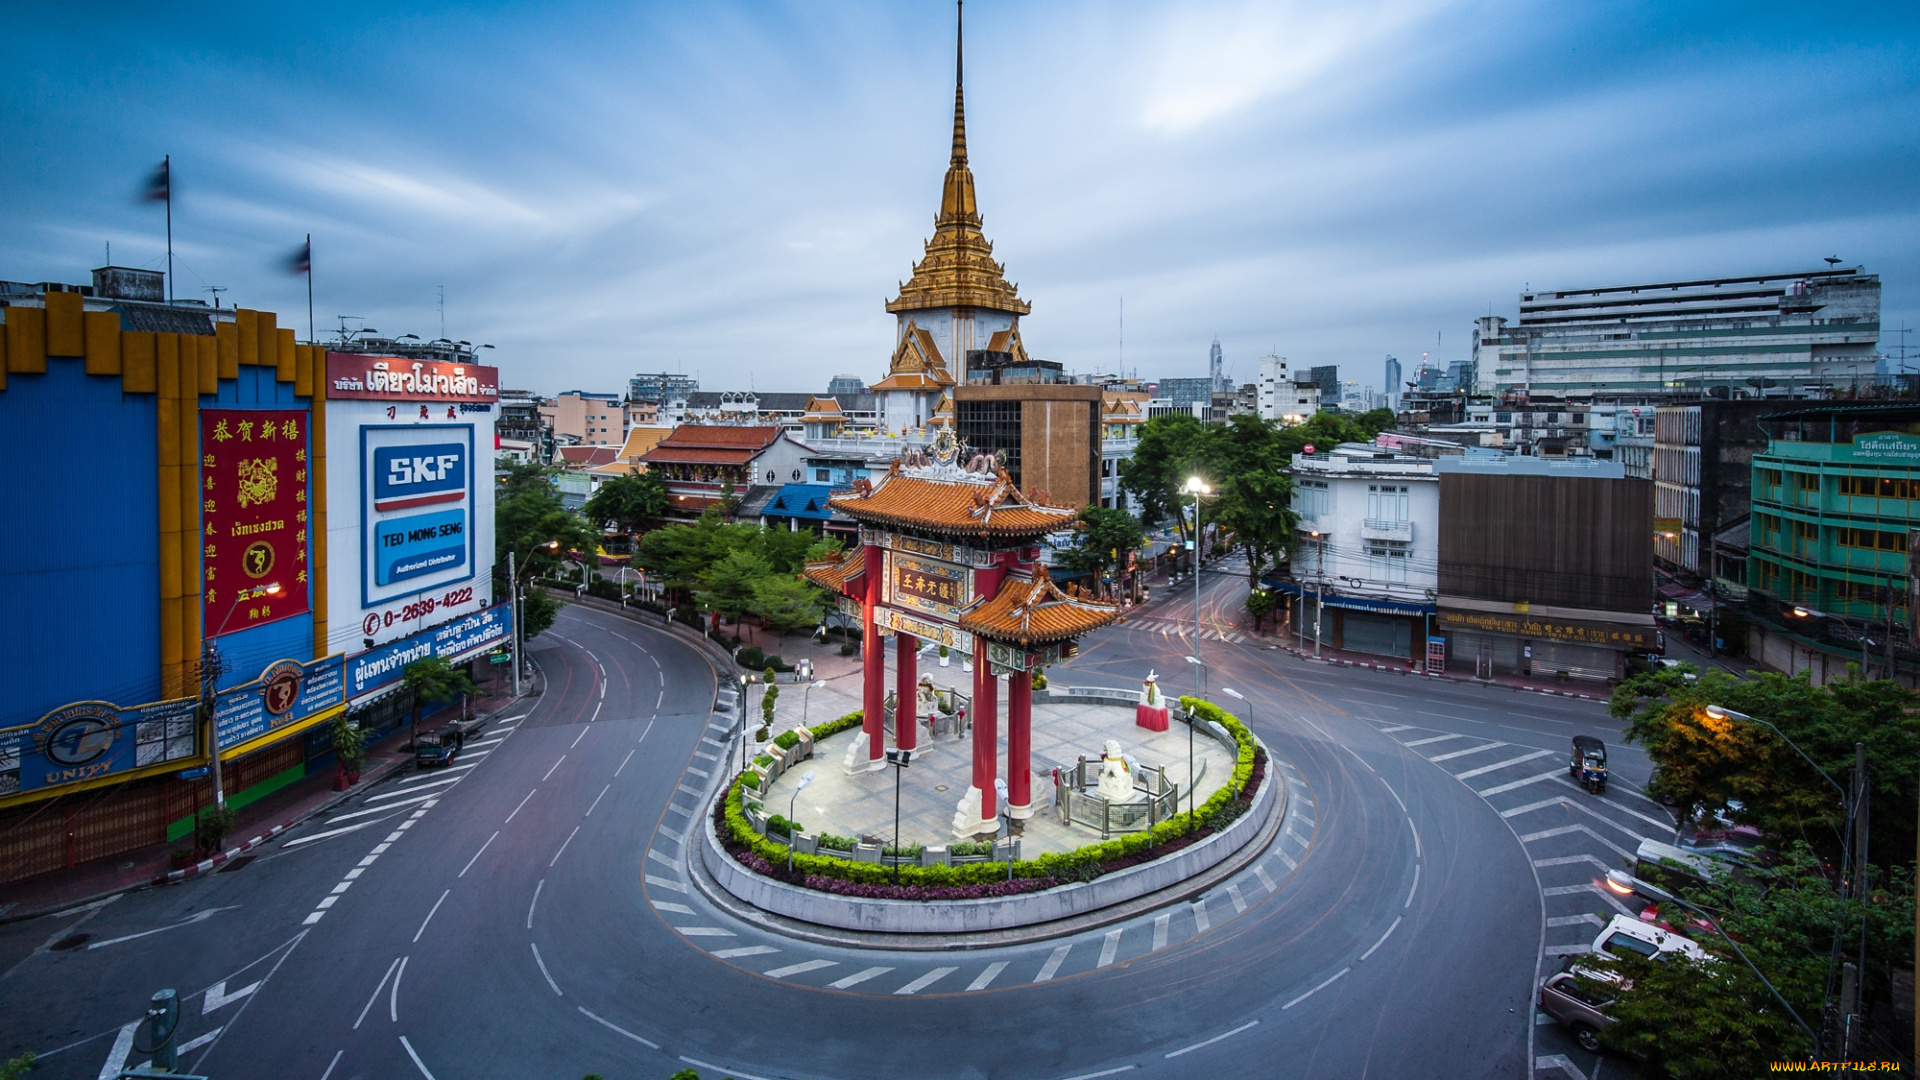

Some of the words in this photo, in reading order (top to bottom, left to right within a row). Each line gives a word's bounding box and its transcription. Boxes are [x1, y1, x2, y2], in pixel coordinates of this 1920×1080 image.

[333, 376, 364, 391] บริษัท
[365, 362, 478, 395] เตียวโม่วเส็ง
[479, 384, 497, 396] จำกัด
[212, 418, 300, 443] 恭贺新禧
[388, 454, 459, 486] SKF
[382, 532, 404, 548] TEO
[408, 525, 437, 544] MONG
[438, 522, 463, 537] SENG
[396, 560, 427, 574] Authorized
[428, 554, 456, 566] Distributor
[383, 586, 473, 627] 0-2639-4222
[46, 761, 113, 783] UNITY
